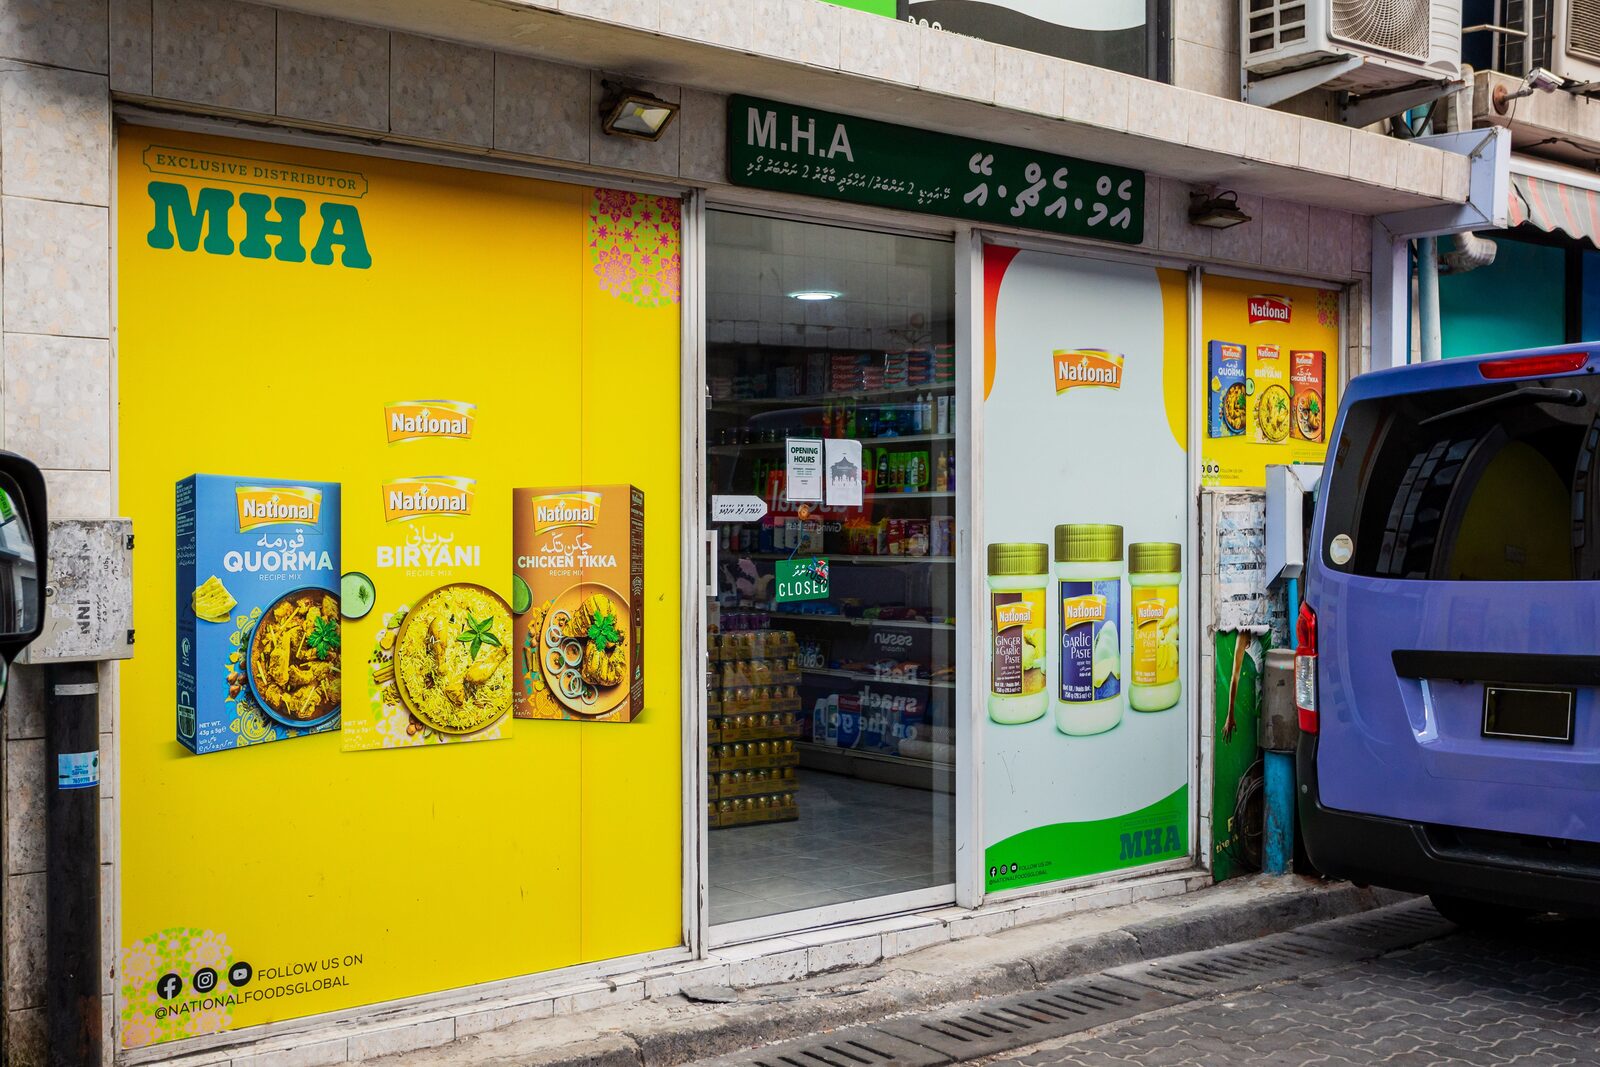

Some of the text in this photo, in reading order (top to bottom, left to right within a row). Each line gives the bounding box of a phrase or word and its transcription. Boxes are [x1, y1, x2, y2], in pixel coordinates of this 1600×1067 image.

[747, 106, 854, 162] M.H.A
[156, 154, 357, 190] EXCLUSIVE DISTRIBUTOR
[801, 165, 810, 178] 2
[147, 181, 372, 270] MHA
[1250, 302, 1288, 319] National
[1057, 360, 1117, 383] National
[1218, 367, 1245, 377] QUORMA
[1254, 368, 1283, 380] BIRYANI
[391, 410, 468, 434] National
[790, 446, 819, 455] OPENING
[793, 455, 816, 463] HOURS
[389, 487, 467, 511] National
[243, 497, 314, 520] National
[537, 502, 595, 522] National
[223, 550, 333, 573] QUORMA
[376, 545, 480, 568] BIRYANI
[517, 555, 617, 568] CHICKEN TIKKA
[259, 573, 302, 581] RECIPE MIX
[406, 569, 453, 577] RECIPE MIX
[572, 569, 584, 577] MIX
[778, 579, 828, 597] CLOSED
[999, 609, 1031, 622] National
[1067, 605, 1102, 618] National
[1139, 605, 1164, 617] National
[199, 721, 210, 729] NET
[1119, 825, 1180, 861] MHA
[258, 953, 363, 981] FOLLOW US ON
[154, 975, 350, 1020] @NATIONALFOODSGLOBAL
